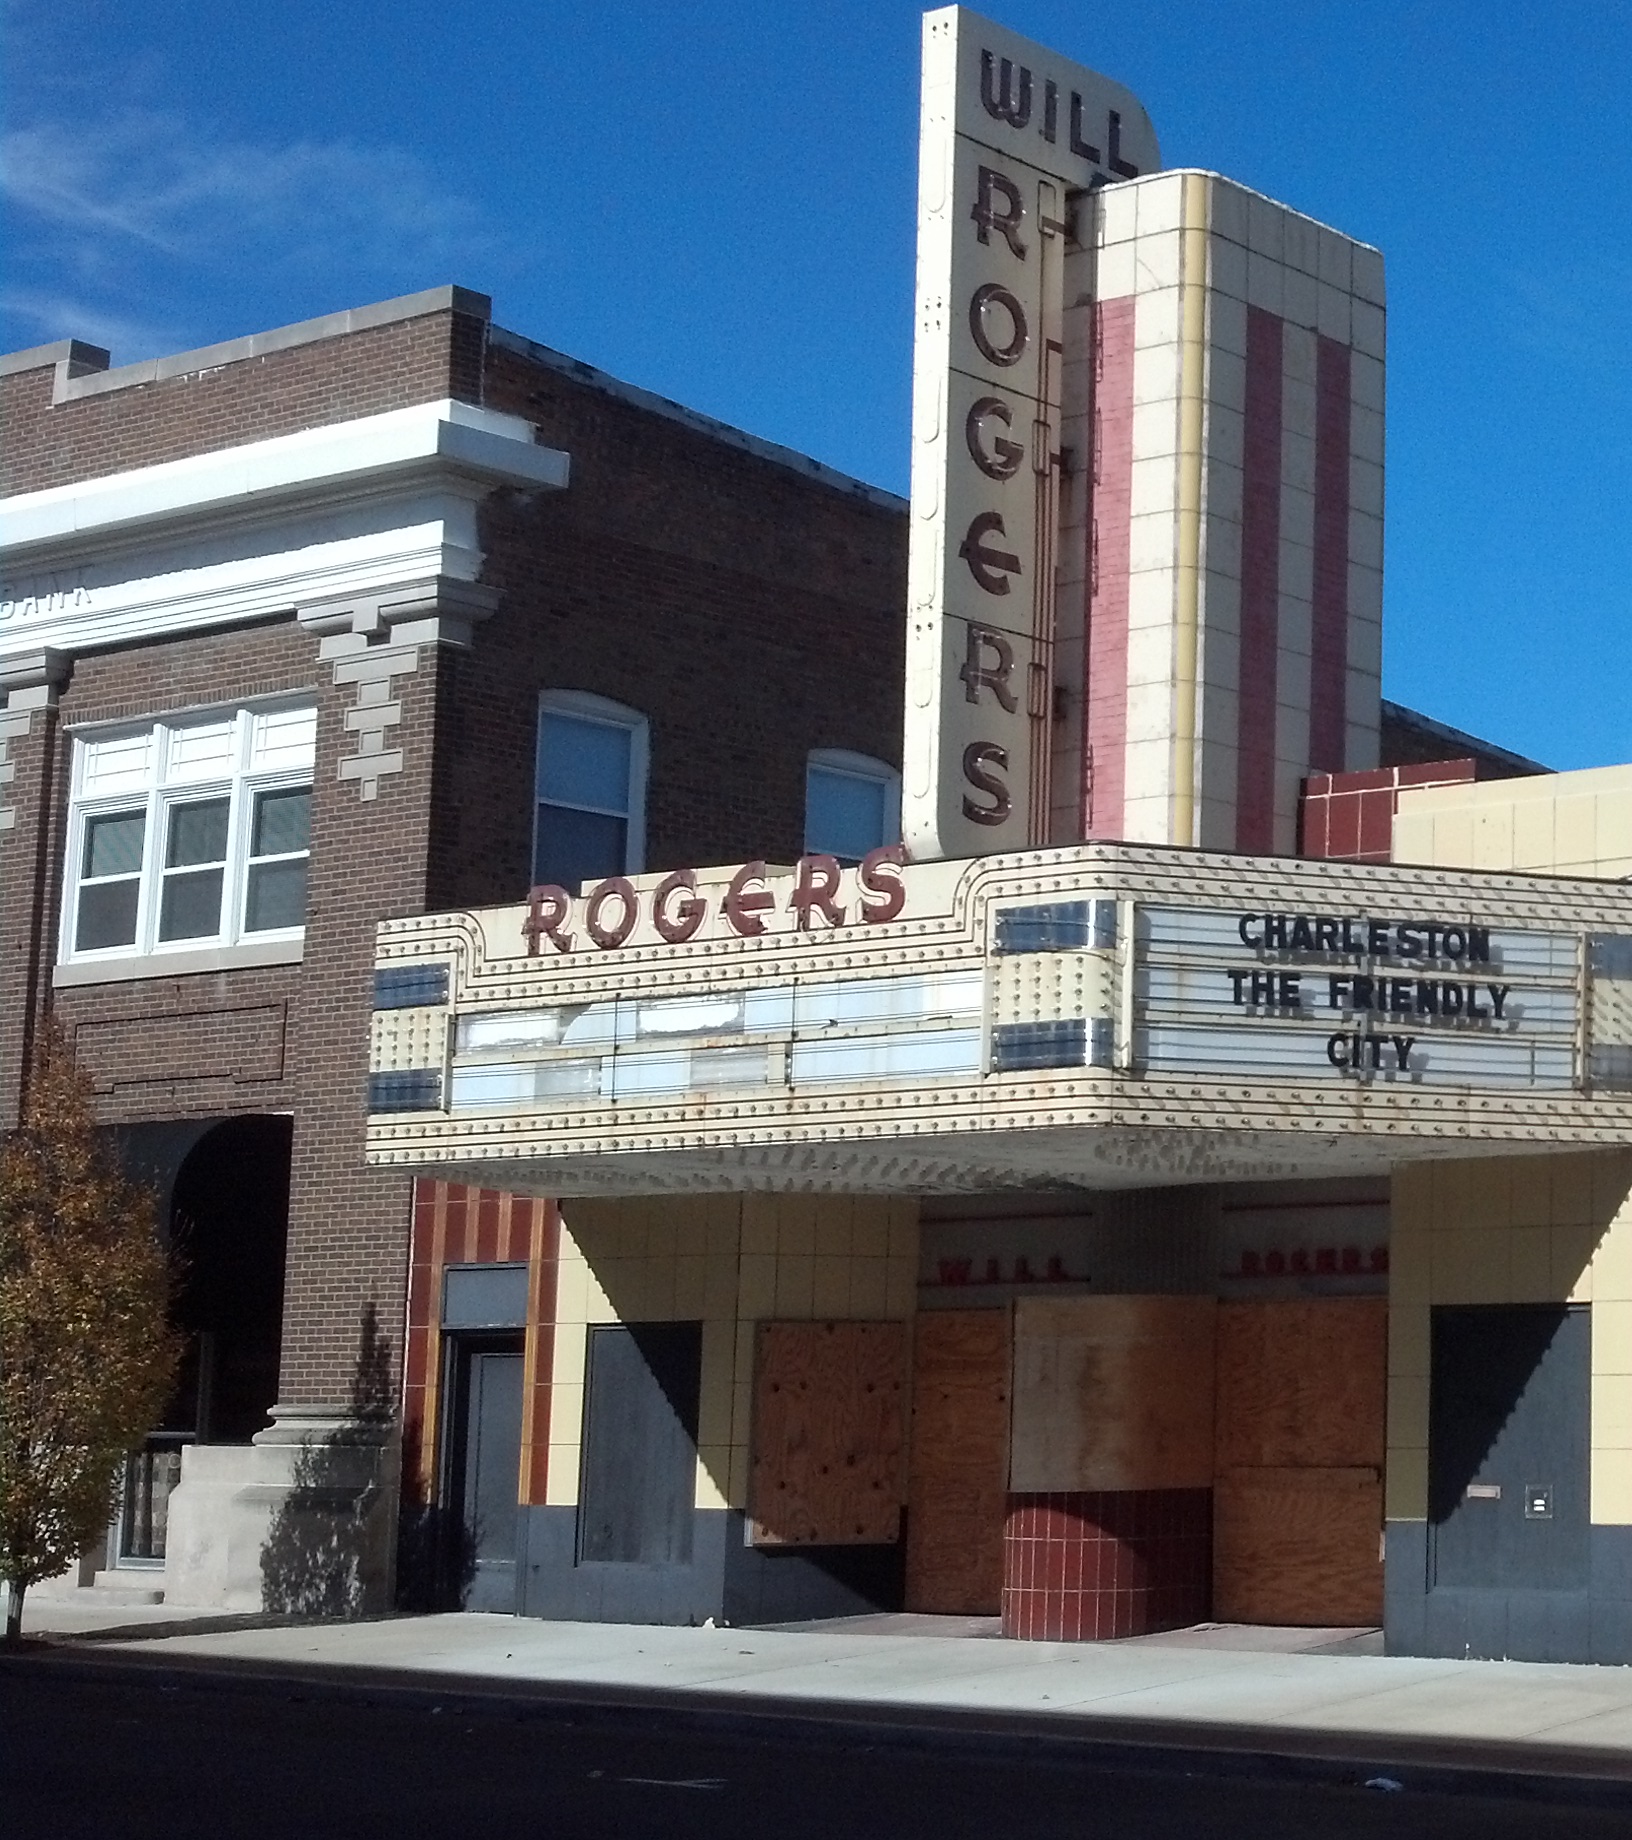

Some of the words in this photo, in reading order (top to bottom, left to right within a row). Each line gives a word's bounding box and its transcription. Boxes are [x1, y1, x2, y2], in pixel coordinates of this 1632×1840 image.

[979, 48, 1139, 177] WILL
[958, 165, 1029, 827] ROGERS
[0, 568, 92, 620] BANK
[521, 845, 907, 956] ROGERS
[1238, 913, 1490, 962] CHARLESTON
[1227, 969, 1302, 1007] THE
[1329, 974, 1512, 1020] FRIENDLY
[1327, 1033, 1416, 1071] CITY
